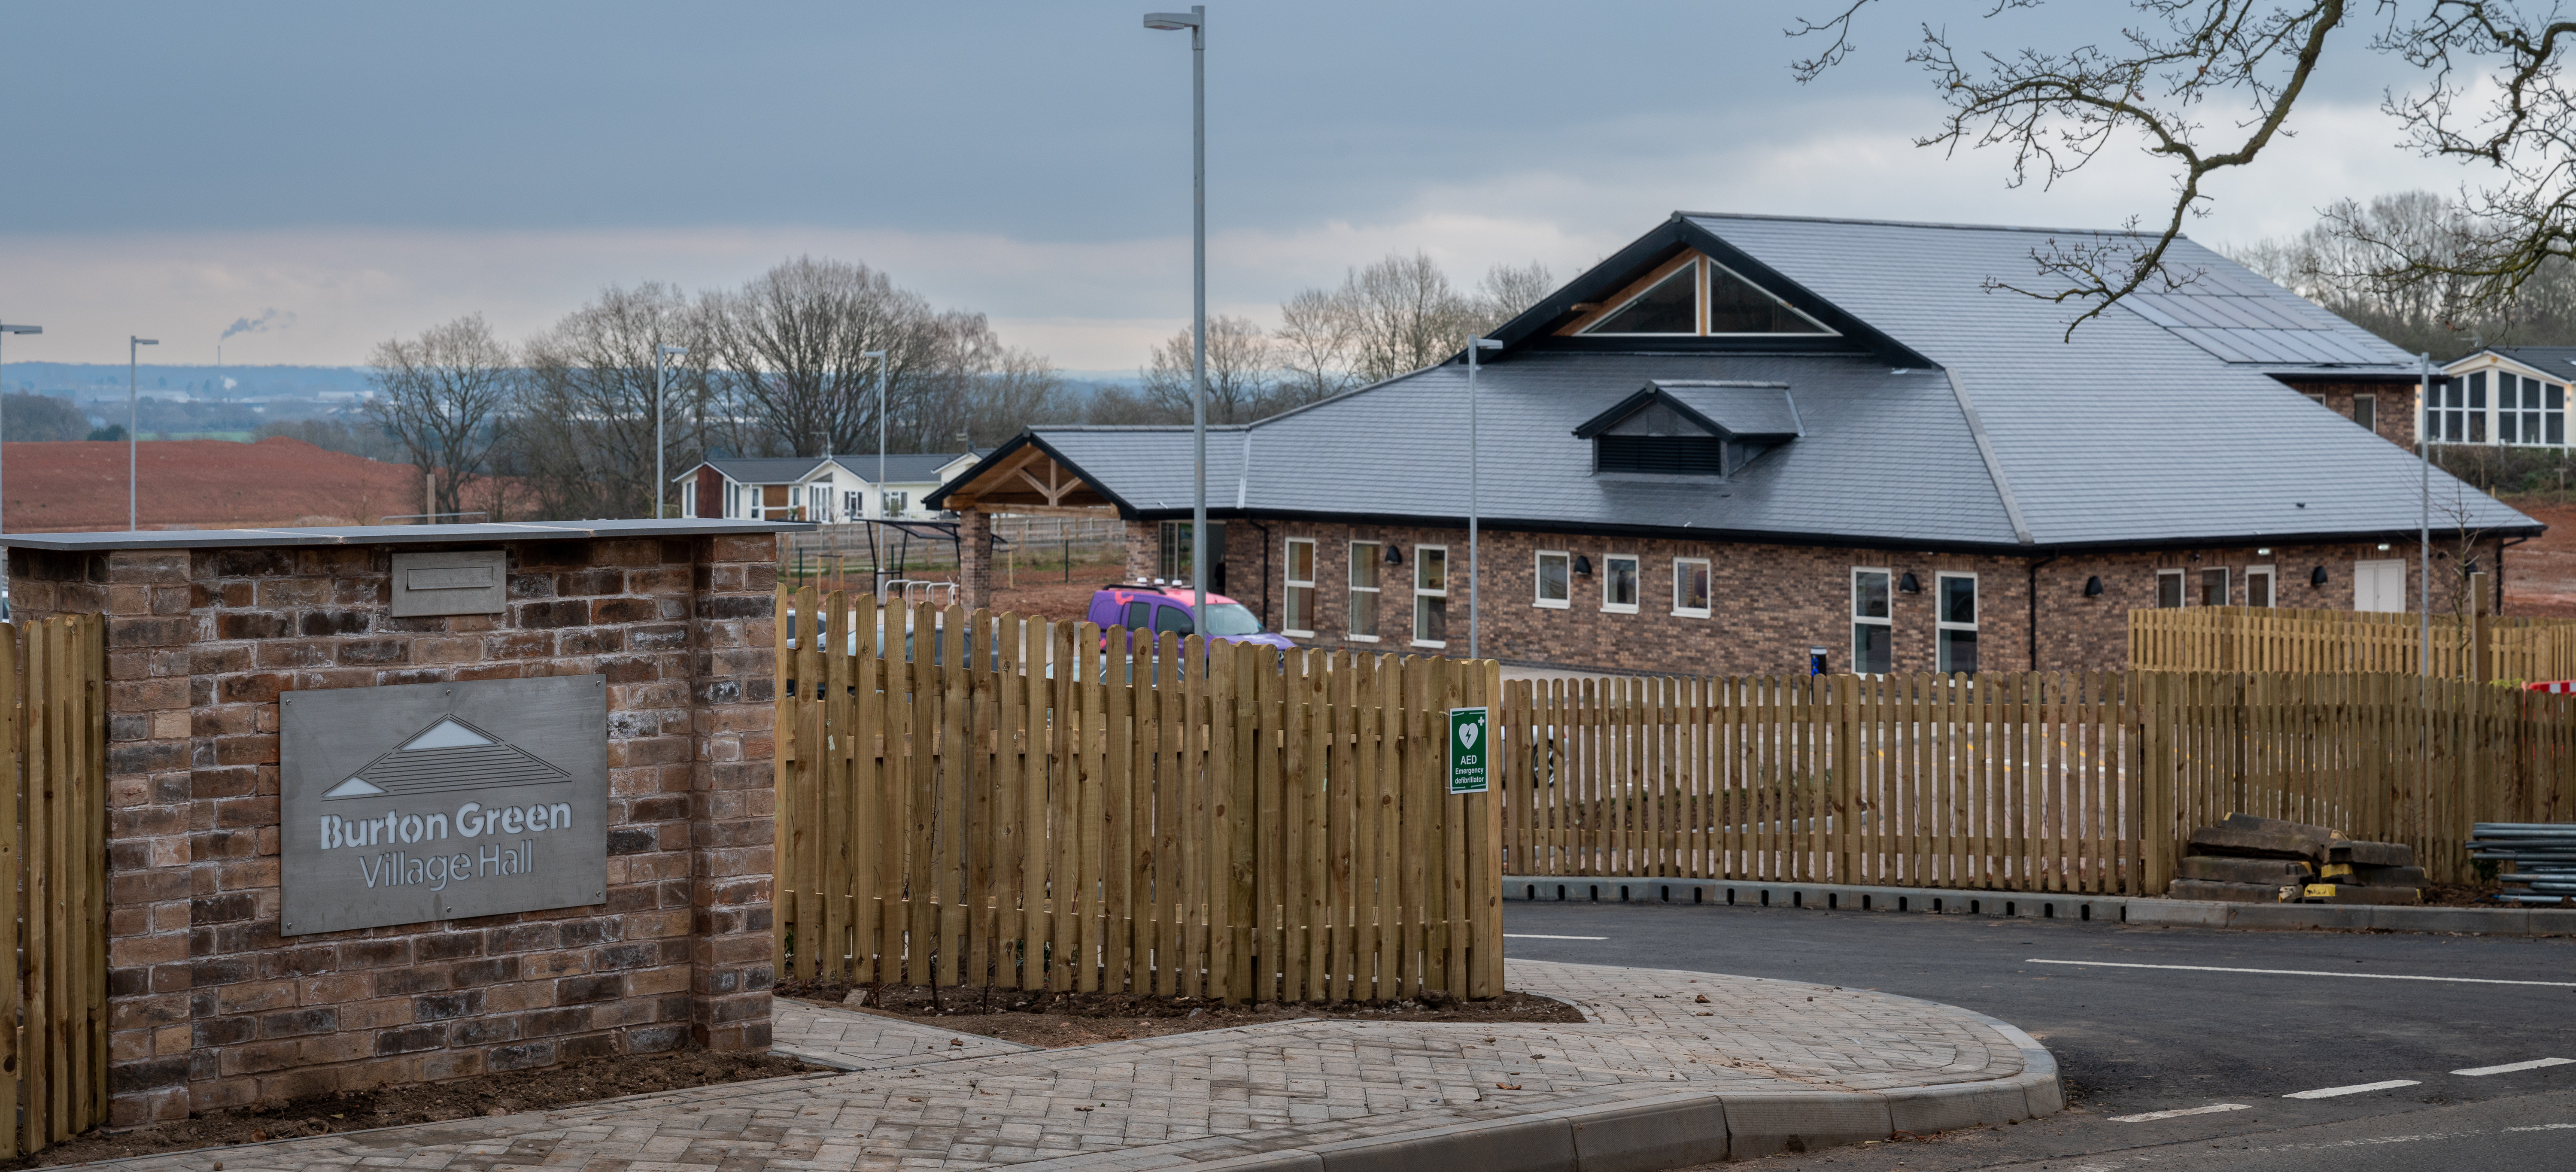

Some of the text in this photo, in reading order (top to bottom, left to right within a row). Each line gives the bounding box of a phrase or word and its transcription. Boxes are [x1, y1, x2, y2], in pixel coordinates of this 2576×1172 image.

[1460, 755, 1477, 765] AED
[321, 802, 572, 850] Burton Green
[359, 839, 534, 892] Village Hall
